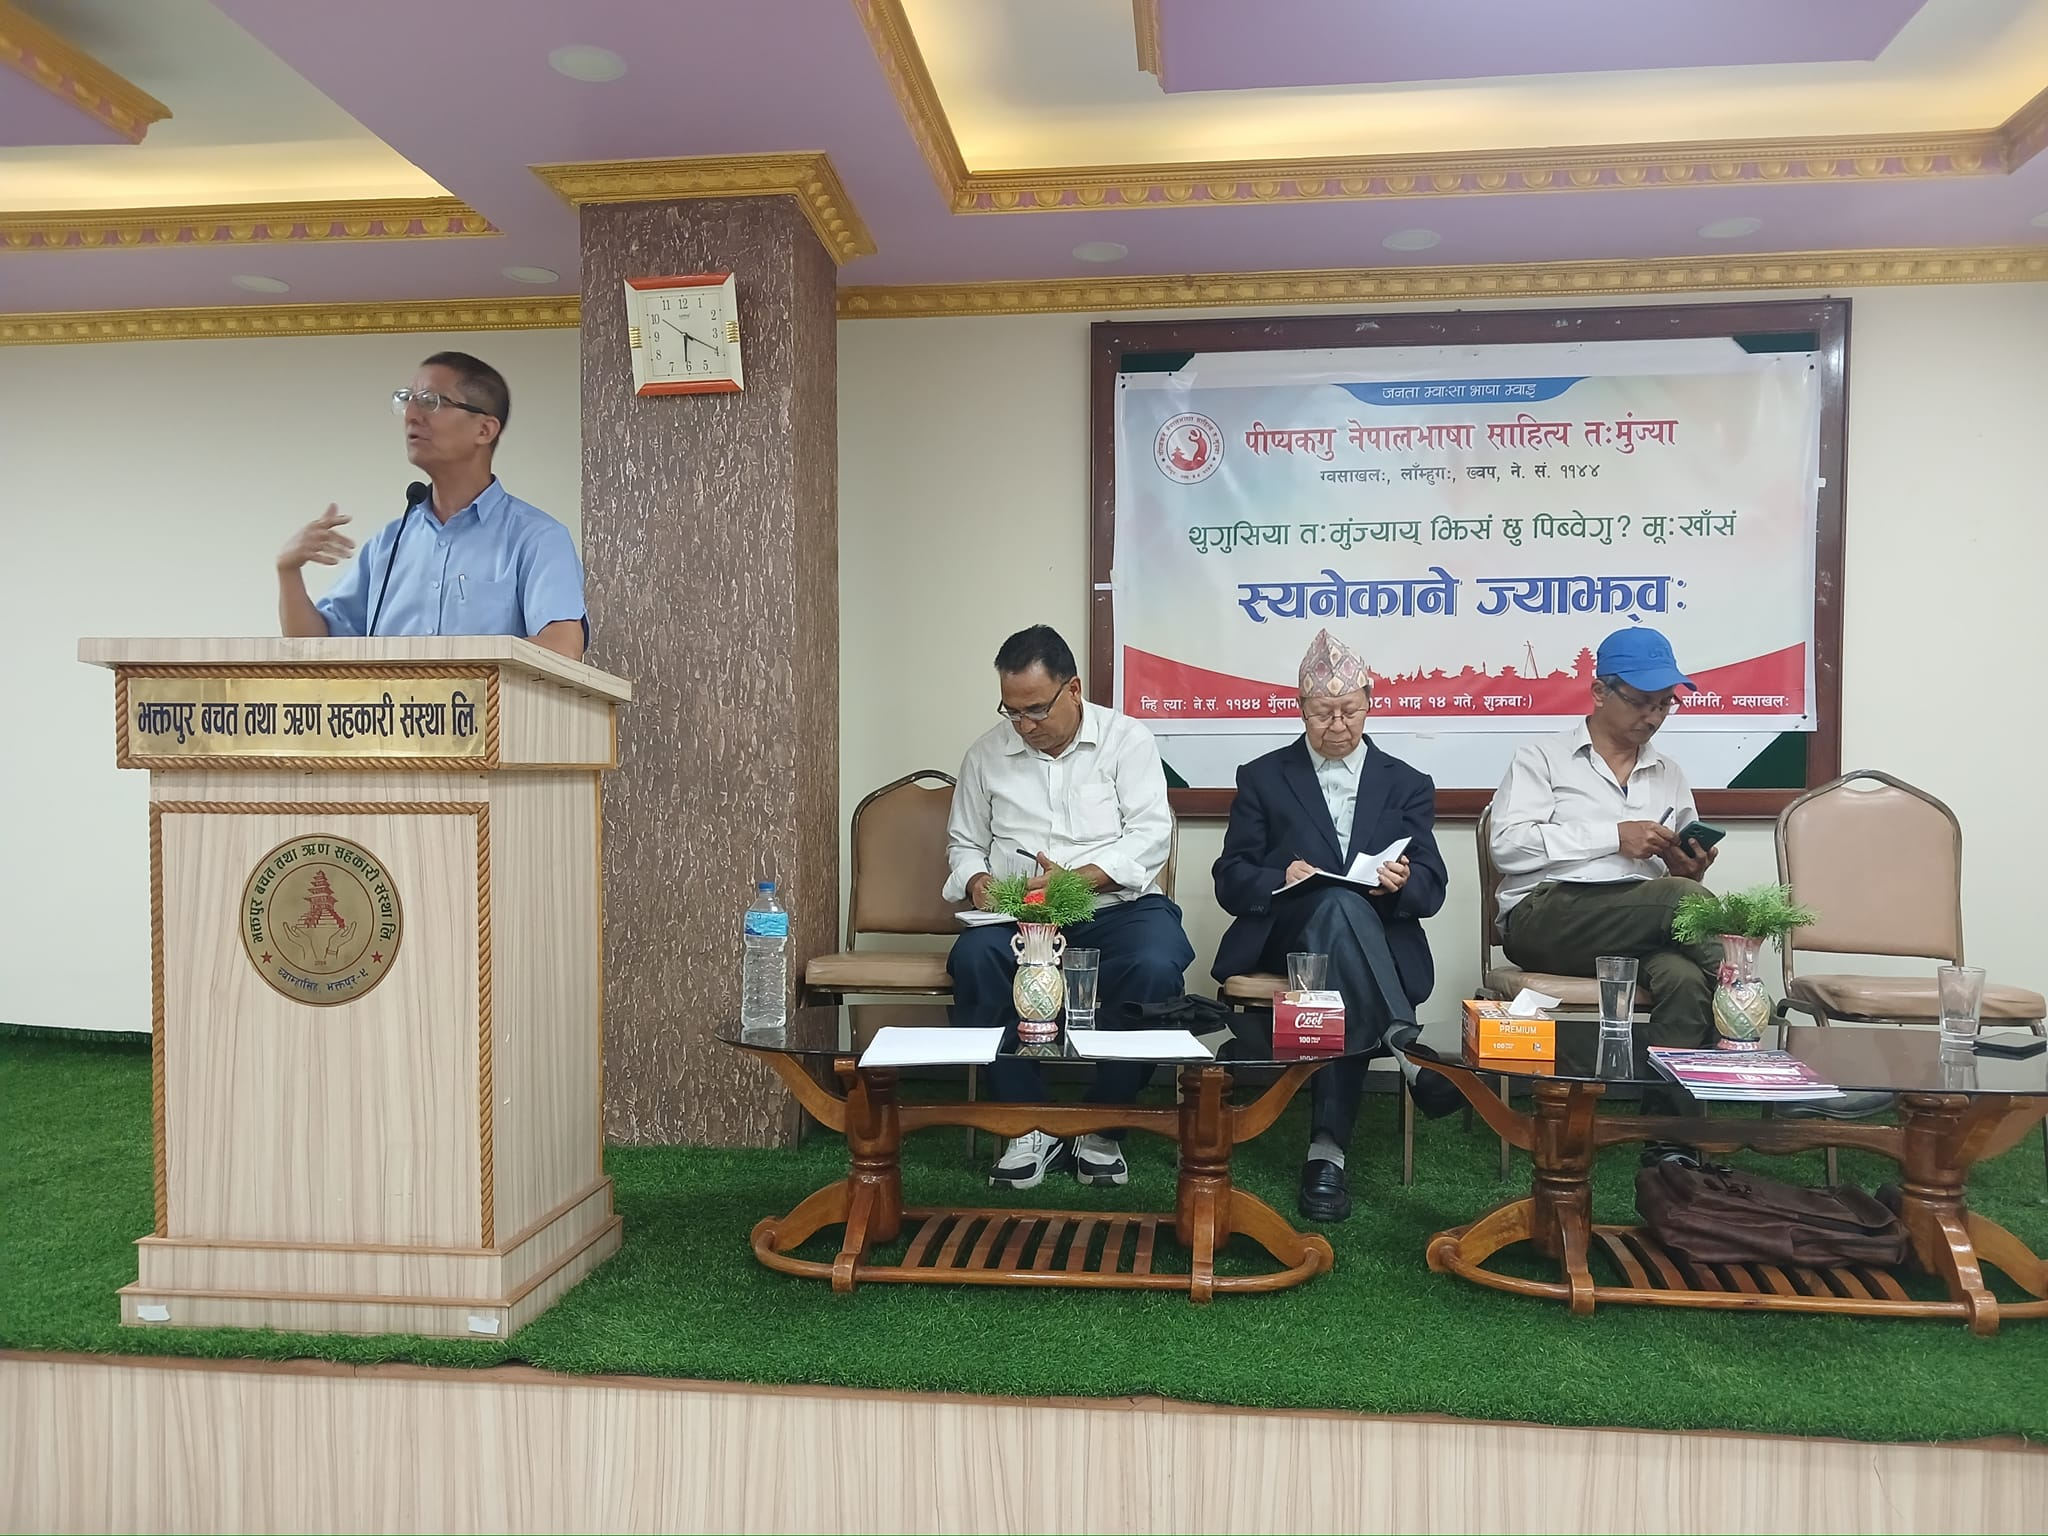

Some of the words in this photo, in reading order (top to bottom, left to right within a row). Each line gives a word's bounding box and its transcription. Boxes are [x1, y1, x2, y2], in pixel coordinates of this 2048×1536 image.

[662, 299, 671, 311] 11
[678, 298, 688, 310] 12
[651, 314, 660, 325] 10
[710, 310, 717, 321] 2
[655, 350, 662, 361] 8
[686, 360, 692, 372] 6
[1382, 386, 1420, 399] जनता
[1470, 384, 1501, 397] भाषा
[1348, 419, 1476, 453] नेपालभाषा
[1487, 413, 1573, 451] साहित्य
[1560, 463, 1601, 479] ११४४
[1188, 520, 1291, 554] थुगुसिया
[1501, 517, 1524, 547] छु
[1238, 566, 1461, 624] स्यनेकाने
[1226, 698, 1261, 711] ११४४
[1428, 695, 1447, 709] १४
[1453, 693, 1476, 710] गते,
[1682, 691, 1725, 710] समिति,
[137, 701, 196, 745] भक्तपुर
[201, 701, 239, 737] बचत
[244, 701, 278, 737] तथा
[283, 702, 322, 737] ऋण
[327, 691, 395, 739] सहकारी
[400, 695, 446, 738] संस्था
[451, 690, 479, 738] लि.
[273, 848, 298, 870] तथा
[301, 843, 330, 857] ऋण
[334, 845, 380, 882] सहकारी
[254, 866, 277, 895] बचत
[374, 881, 393, 919] संस्था
[249, 896, 265, 944] भक्तपुर
[1294, 1011, 1324, 1029] Cool
[1499, 1025, 1538, 1034] PREMIUM
